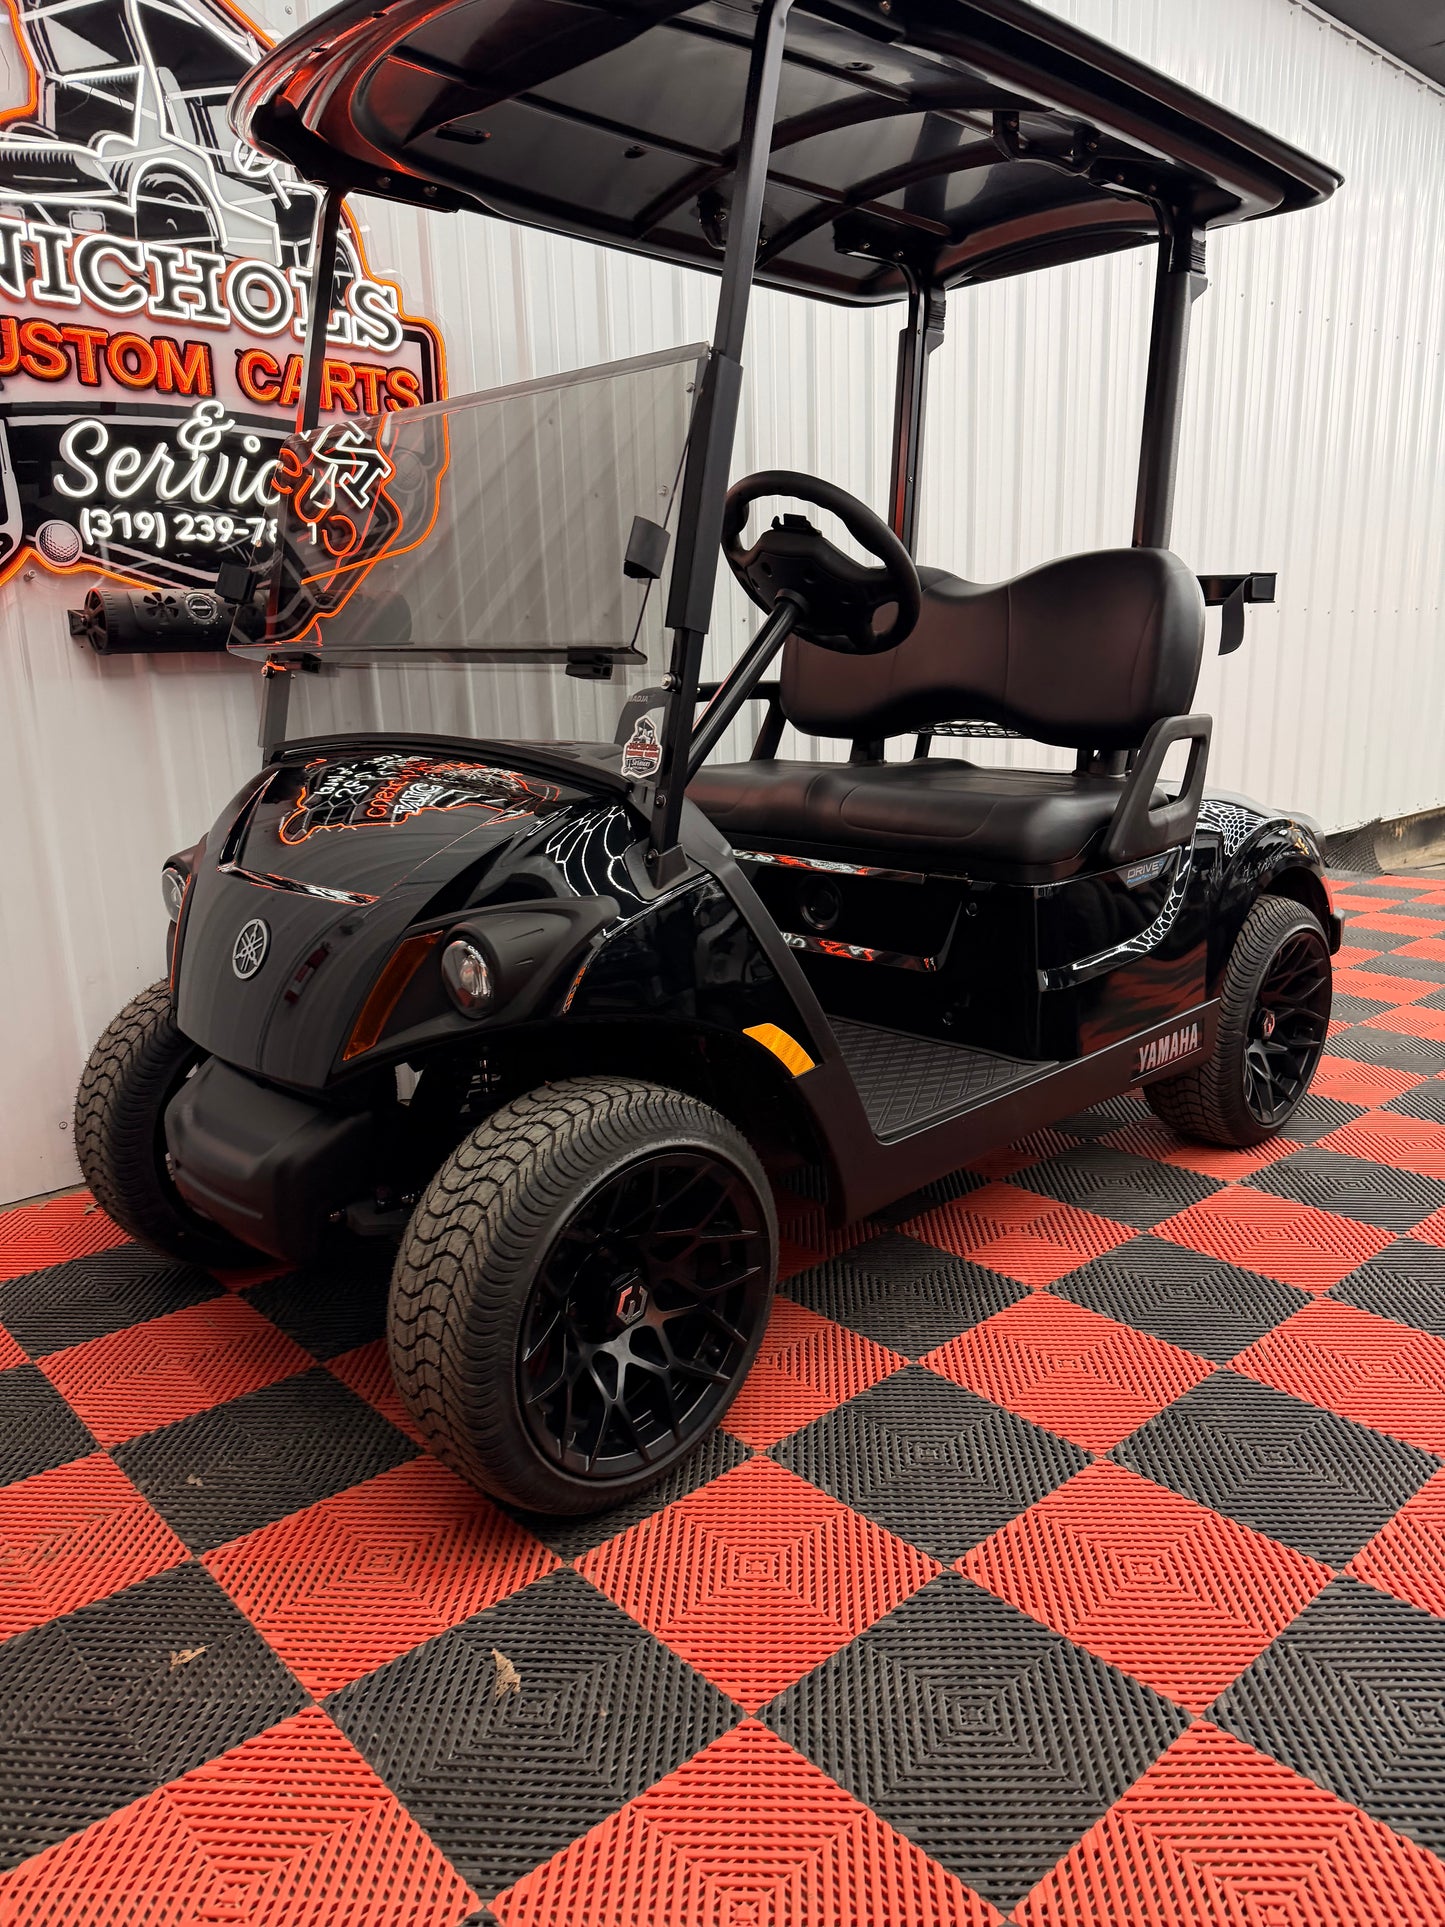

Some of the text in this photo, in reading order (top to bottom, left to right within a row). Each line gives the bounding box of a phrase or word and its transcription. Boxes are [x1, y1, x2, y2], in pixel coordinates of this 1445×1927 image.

[177, 400, 235, 461] &
[80, 507, 317, 548] (319) 239-781
[1138, 1022, 1199, 1073] YAMAHA
